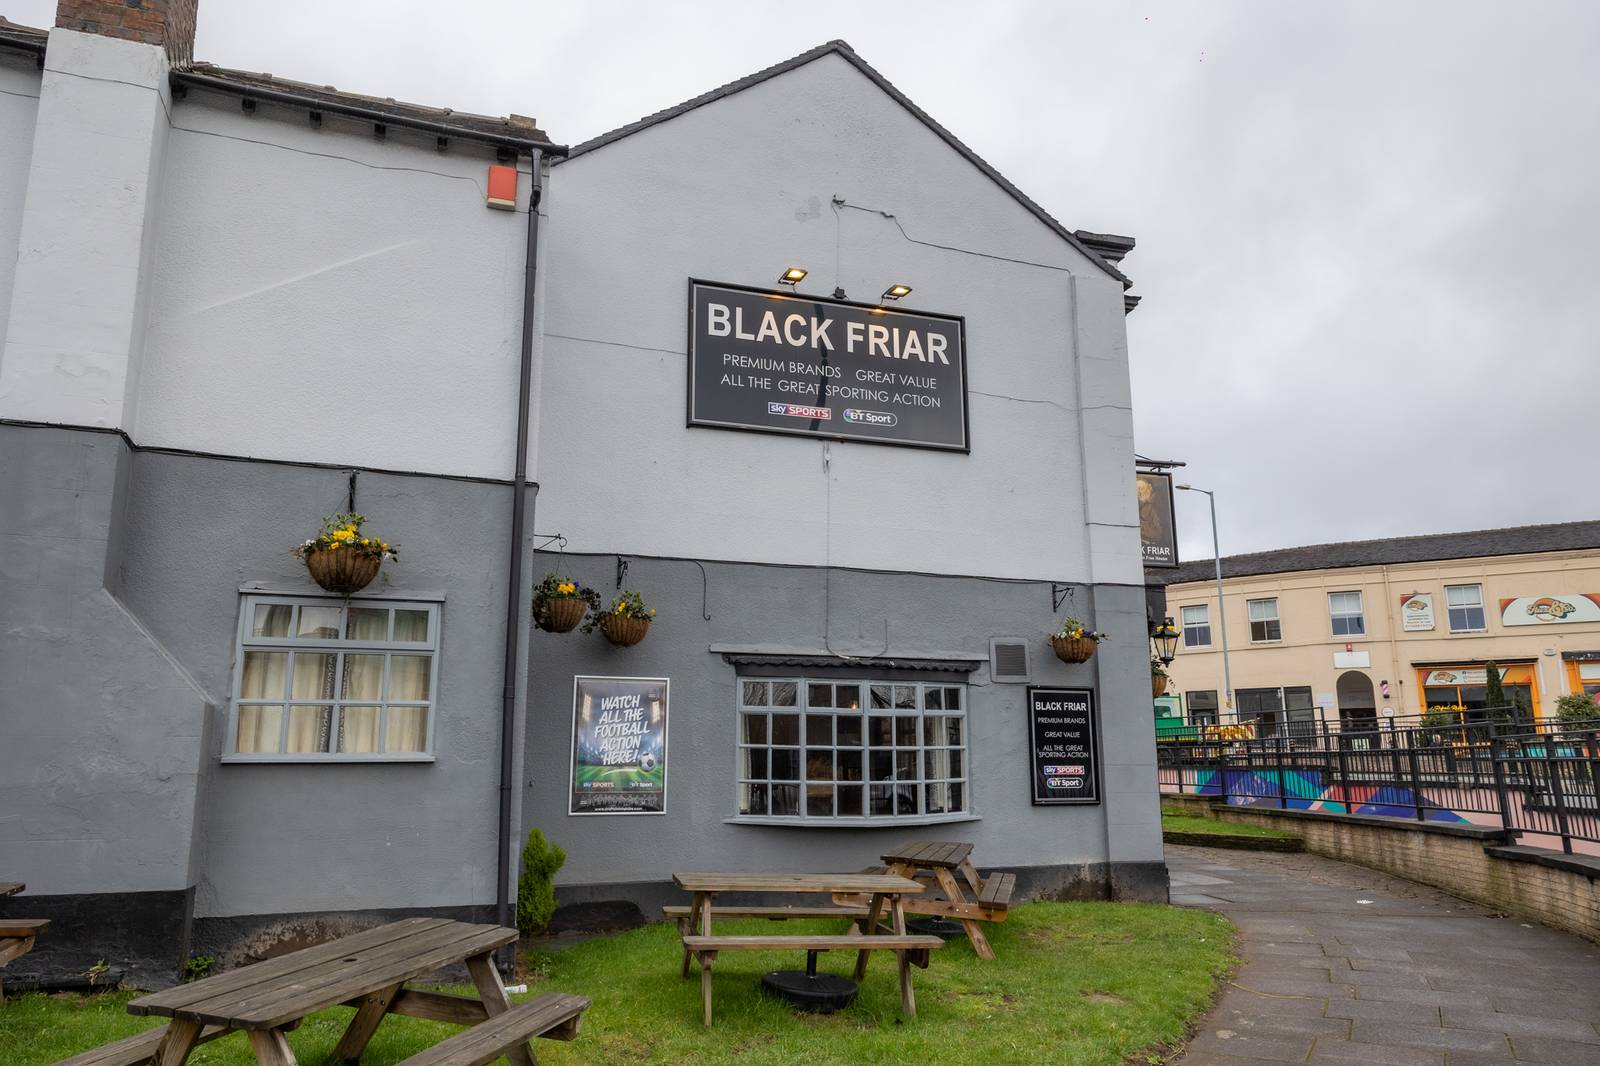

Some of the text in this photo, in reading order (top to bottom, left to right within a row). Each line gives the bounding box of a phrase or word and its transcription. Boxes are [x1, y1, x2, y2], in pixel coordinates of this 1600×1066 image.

[707, 302, 950, 366] BLACK FRIAR
[723, 353, 937, 389] PREMIUM BRANDS GREAT VALUE
[720, 373, 941, 408] ALL THE GREAT SPORTING ACTION
[770, 404, 829, 418] sky SPORTS
[851, 410, 891, 425] BT Sport
[1147, 546, 1170, 555] FRIAR
[601, 694, 641, 710] WATCH
[1035, 701, 1087, 711] BLACK FRIAR
[599, 707, 644, 725] ALL THE
[594, 721, 650, 739] FOOTBALL
[599, 735, 642, 753] ACTION
[602, 749, 638, 766] HERE!
[1045, 766, 1083, 774] sky SPORTS
[1061, 779, 1079, 787] Sport
